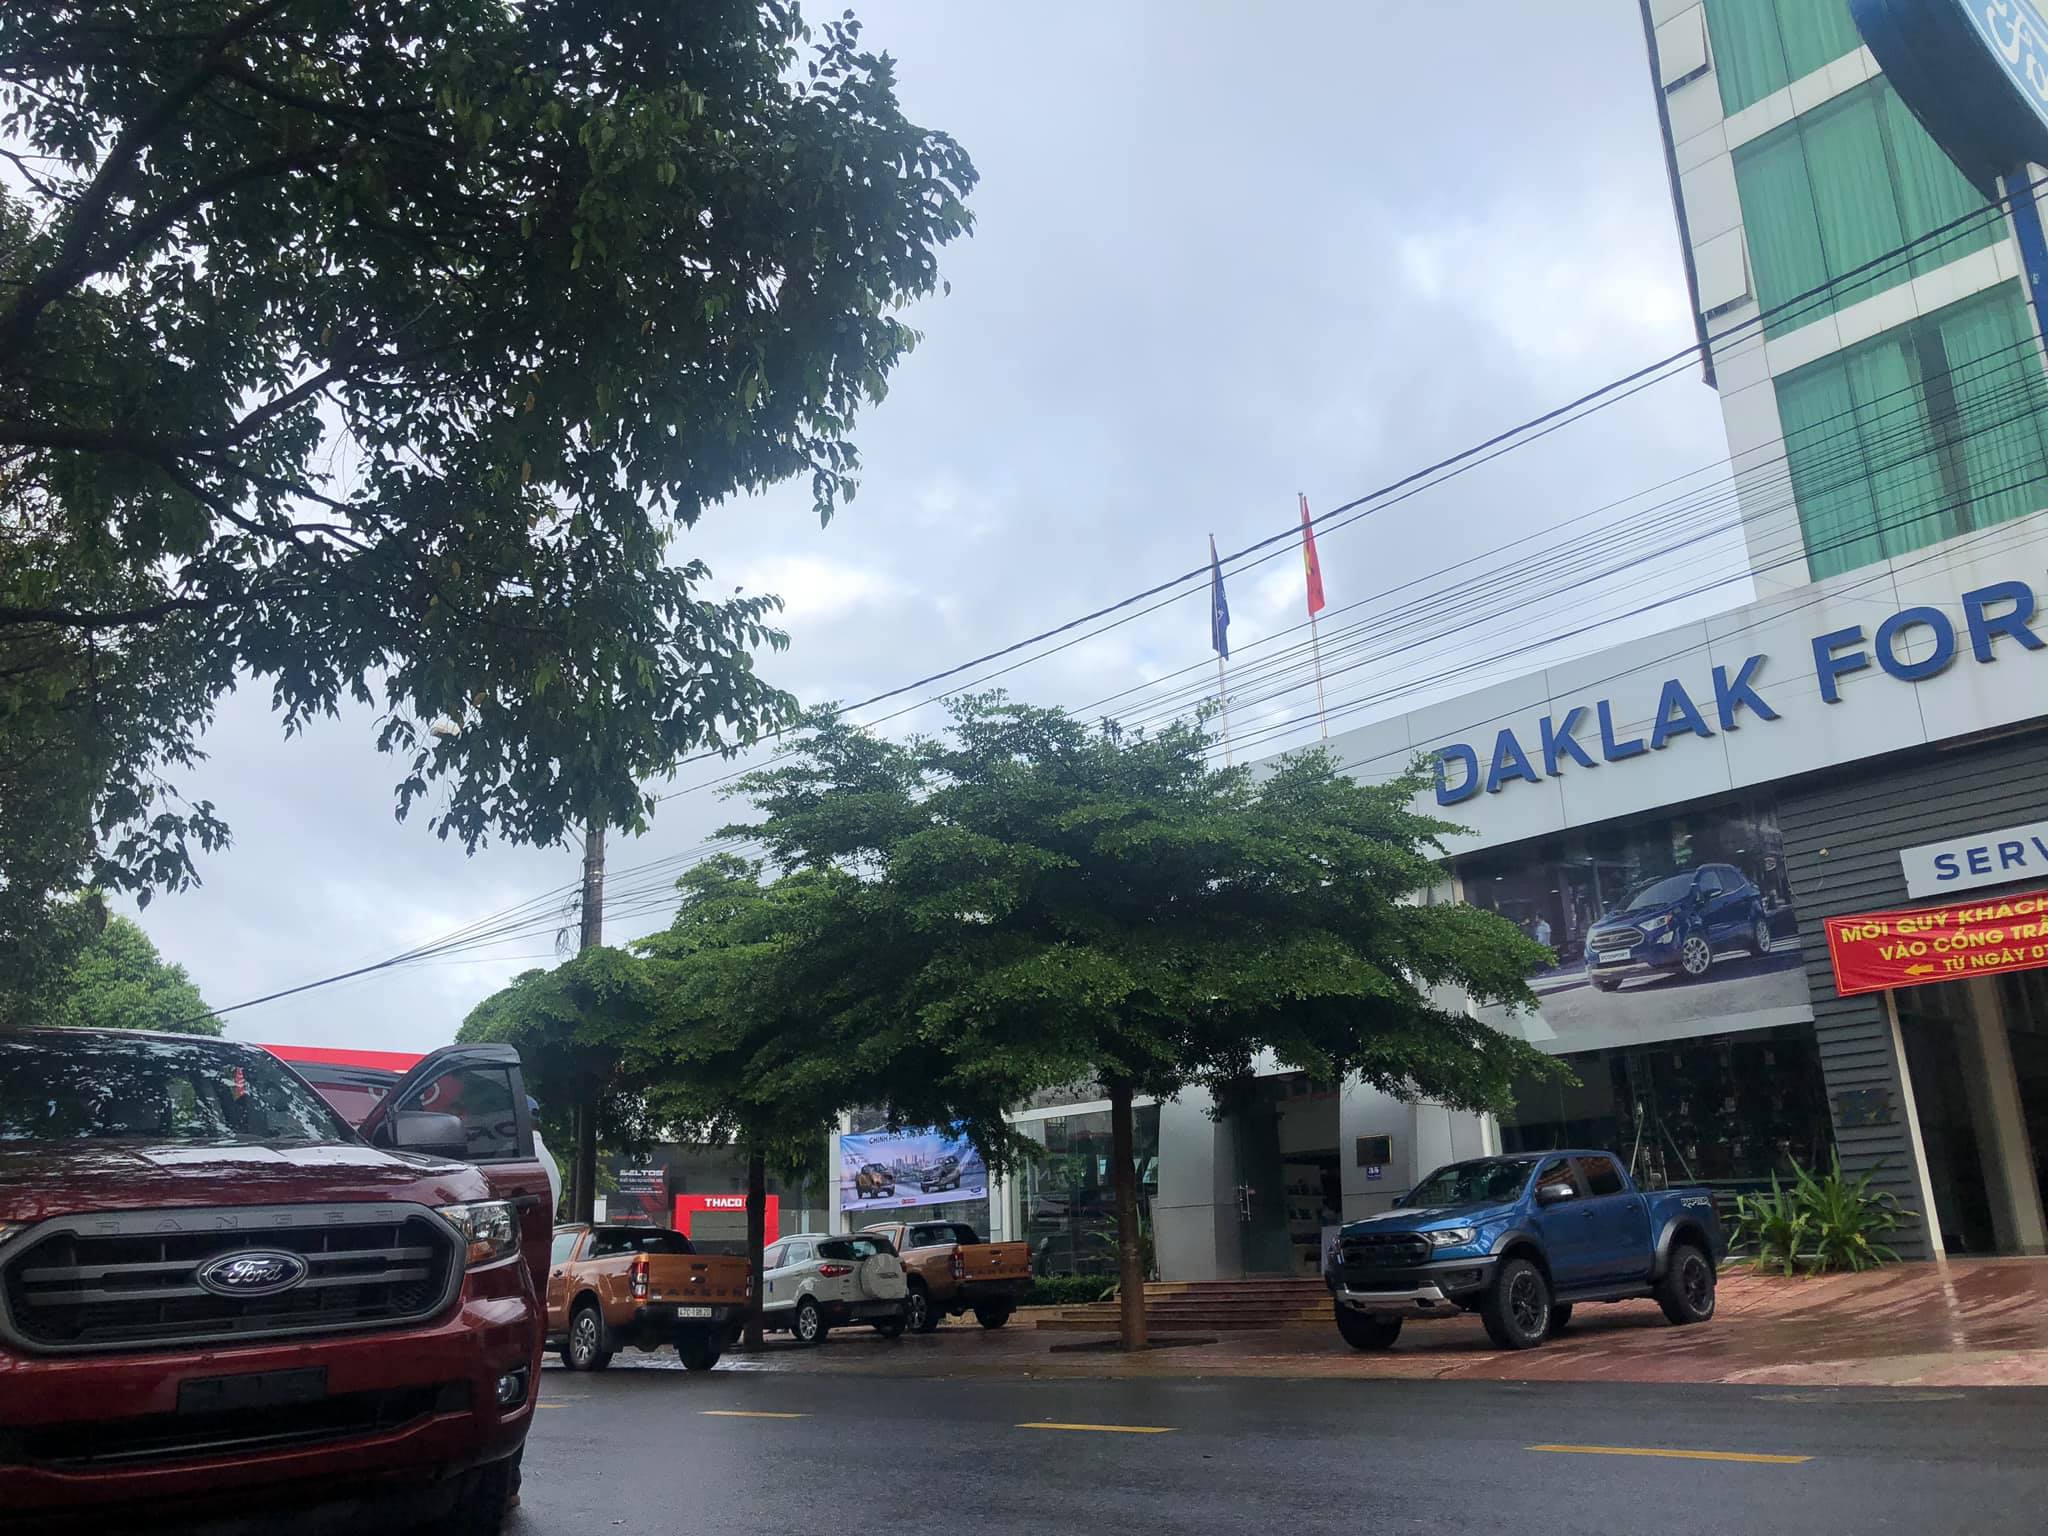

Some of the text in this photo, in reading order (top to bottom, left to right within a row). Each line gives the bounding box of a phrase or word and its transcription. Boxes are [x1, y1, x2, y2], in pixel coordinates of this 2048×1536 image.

[1432, 654, 1781, 807] DAKLAK
[1840, 919, 1889, 943] MỜI
[1896, 910, 1949, 934] QUÝ
[1879, 940, 1927, 961] VÀO
[1933, 927, 2004, 953] CỔNG
[1943, 954, 1965, 972] TỪ
[1971, 947, 2025, 968] NGÀY
[704, 1197, 743, 1208] THACO
[96, 1209, 393, 1233] RANGER
[225, 1259, 284, 1284] Ford
